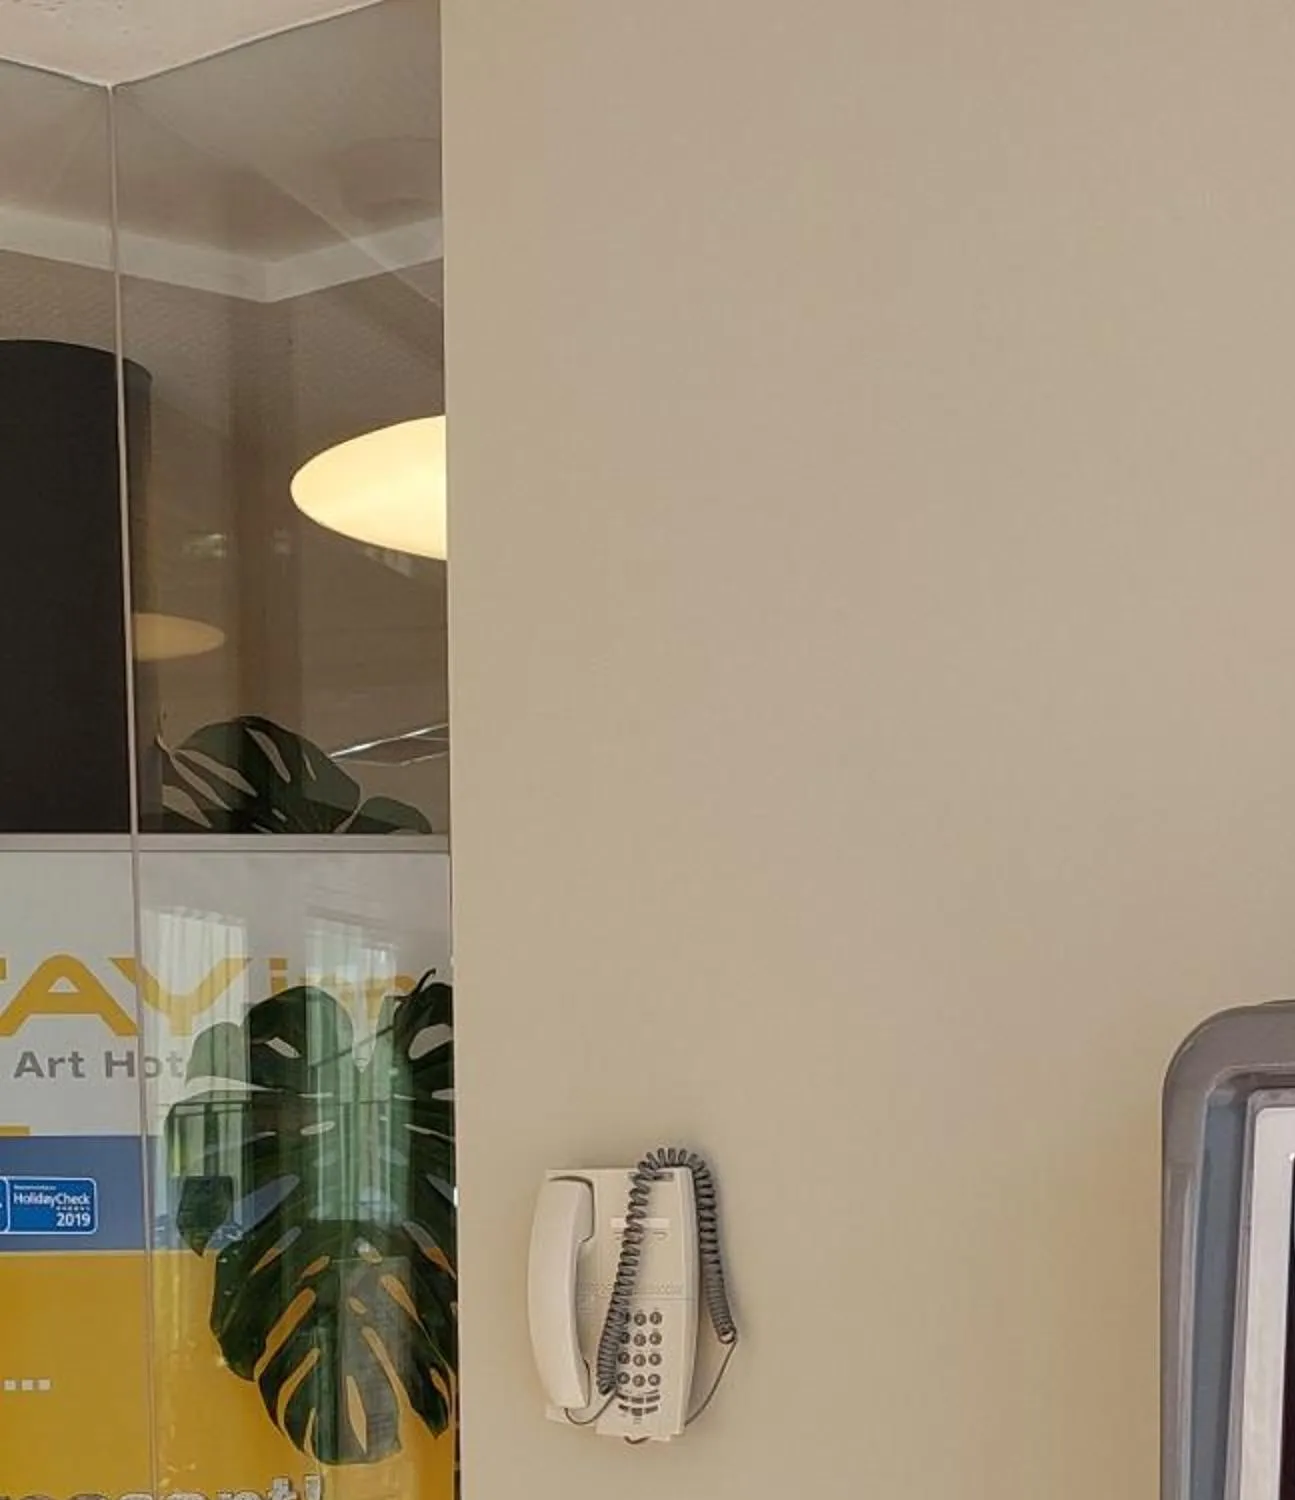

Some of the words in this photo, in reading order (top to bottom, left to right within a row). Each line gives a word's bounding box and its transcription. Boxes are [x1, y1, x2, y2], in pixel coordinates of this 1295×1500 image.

[0, 953, 251, 1037] AY
[14, 1050, 86, 1078] Art
[104, 1050, 184, 1079] Hot
[13, 1192, 91, 1208] HolidayCheck
[56, 1212, 91, 1227] 2019
